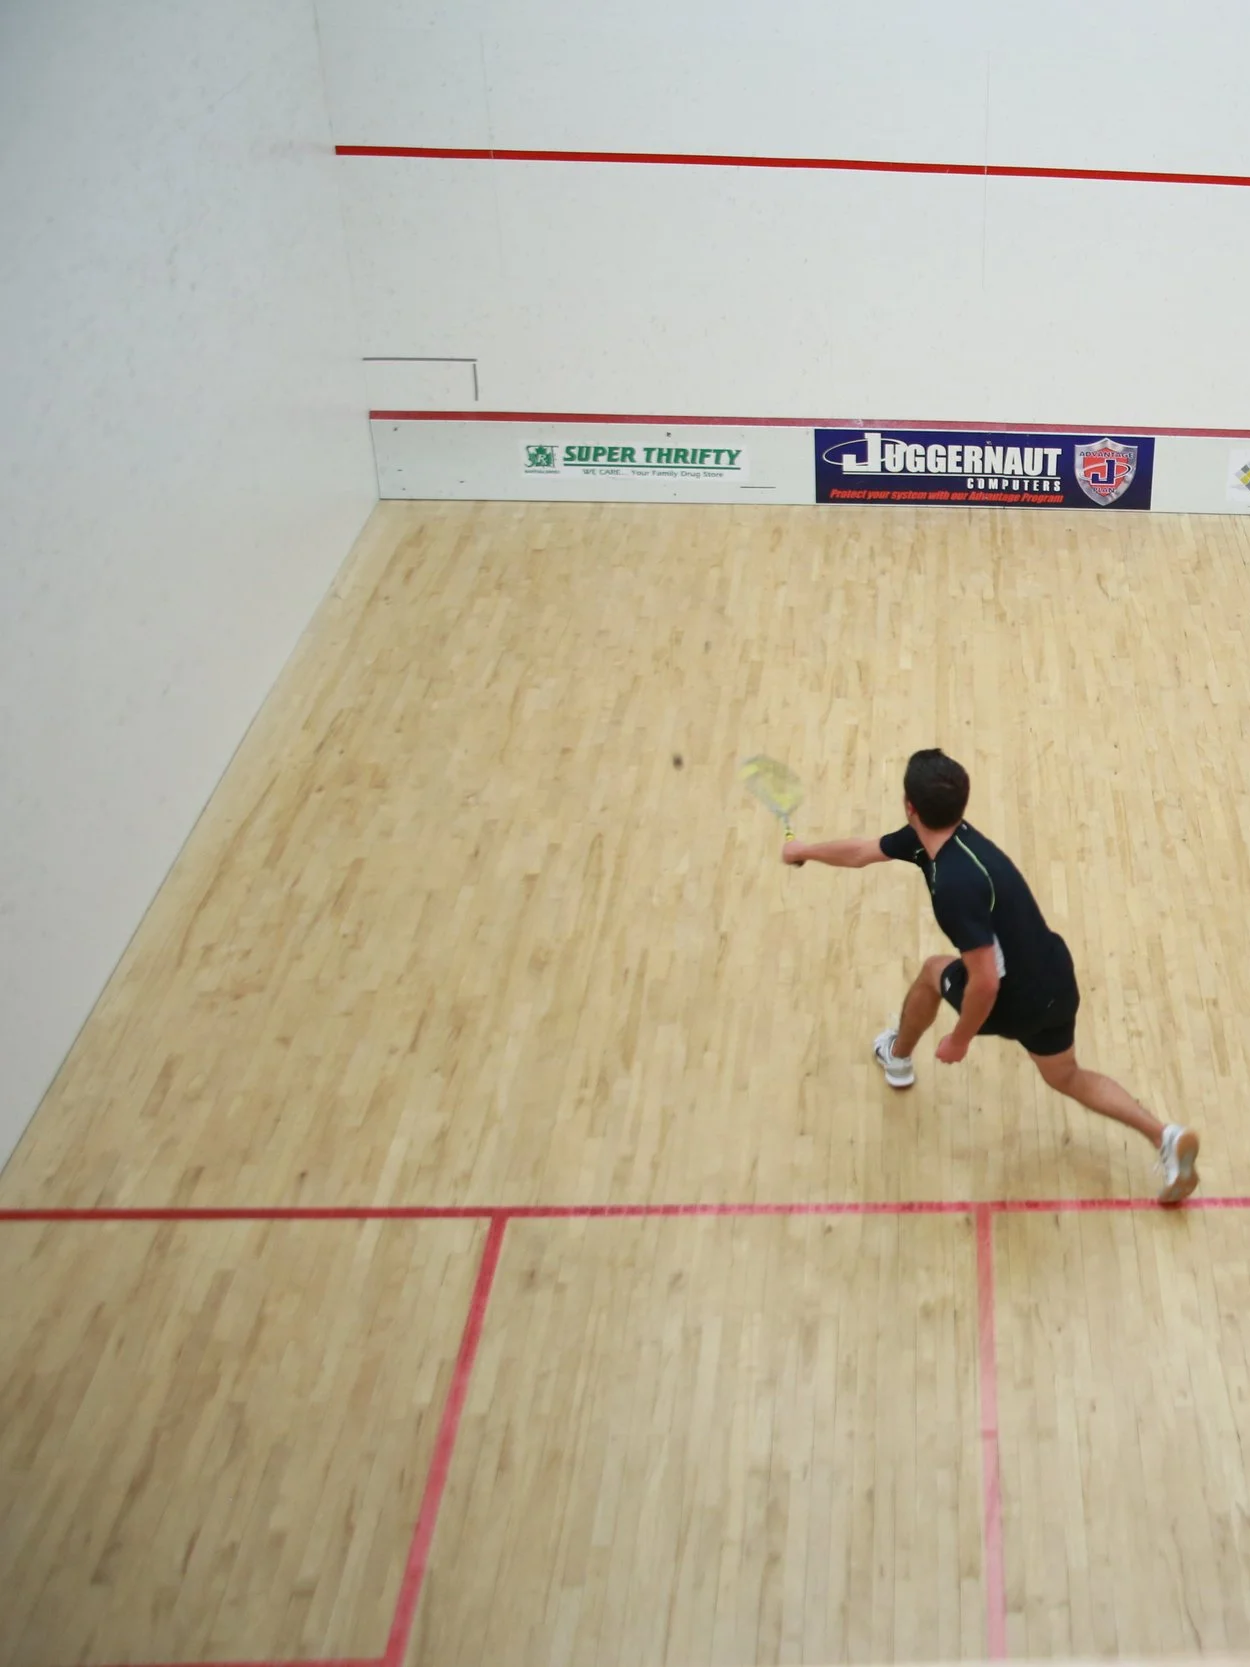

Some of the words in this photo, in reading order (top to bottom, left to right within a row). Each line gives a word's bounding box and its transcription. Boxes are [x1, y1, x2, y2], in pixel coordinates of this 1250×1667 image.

[563, 445, 636, 463] SUPER
[643, 447, 742, 465] THRIFTY
[842, 432, 1062, 476] JUGGERNAUT
[1079, 451, 1134, 459] ADVANTAGE
[652, 470, 678, 478] Family
[680, 470, 701, 479] Drug
[967, 478, 1061, 492] COMPUTERS
[830, 488, 867, 498] Protect
[867, 491, 890, 500] your
[891, 491, 927, 501] system
[928, 491, 950, 500] with
[950, 492, 968, 500] our
[968, 491, 1020, 503] Advantage
[1021, 493, 1064, 503] Program
